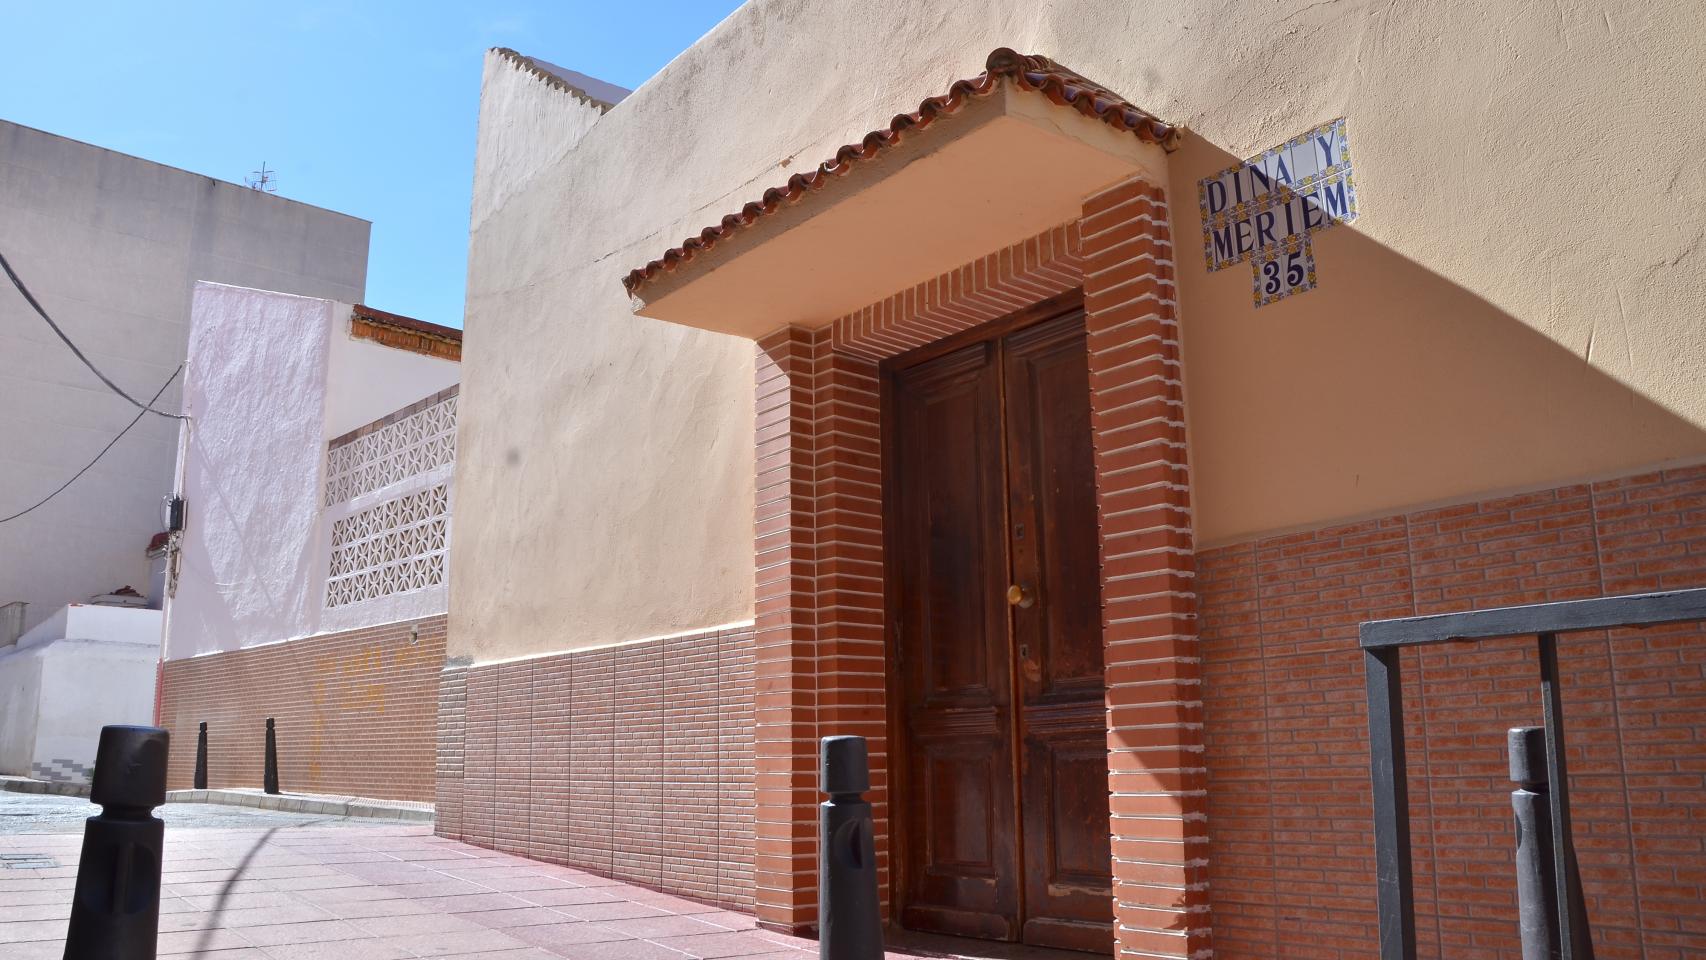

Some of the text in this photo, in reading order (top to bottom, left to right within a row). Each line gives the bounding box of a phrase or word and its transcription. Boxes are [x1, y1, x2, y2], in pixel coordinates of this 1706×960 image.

[1207, 131, 1335, 214] DINA Y
[1213, 181, 1348, 263] MERIEM
[1263, 252, 1304, 294] 35
